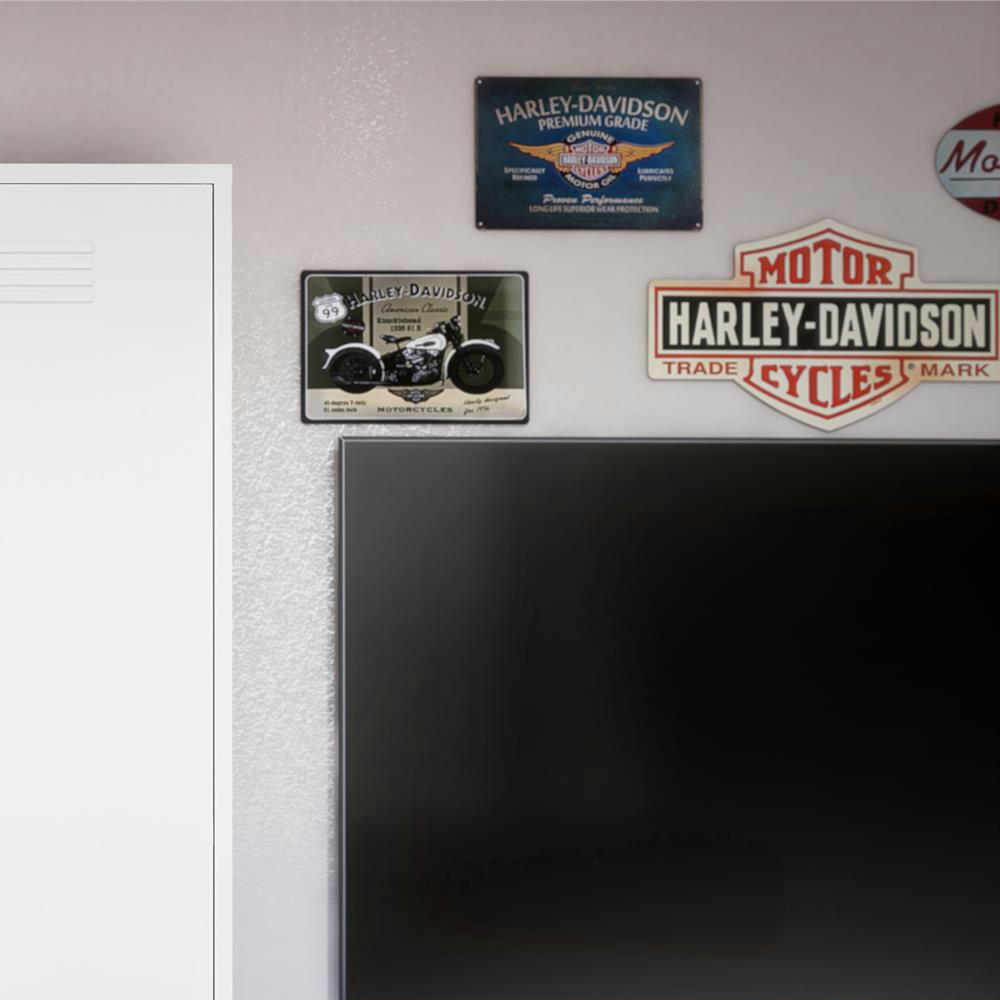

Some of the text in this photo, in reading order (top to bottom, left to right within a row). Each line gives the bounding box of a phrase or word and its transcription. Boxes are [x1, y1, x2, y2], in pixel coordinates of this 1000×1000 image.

[495, 93, 689, 127] HARLEY-DAVIDSON
[538, 115, 650, 132] PREMIUM GRADE
[566, 129, 616, 144] GENUINE
[564, 173, 617, 189] MOTOR OIL
[758, 238, 893, 285] MOTOR
[346, 283, 488, 311] HARLEY-DAVIDSON
[322, 306, 340, 319] 99
[668, 301, 987, 348] HARLEY-DAVIDSON
[662, 361, 739, 375] TRADE
[920, 363, 990, 377] MARK
[760, 364, 893, 409] CYCLES
